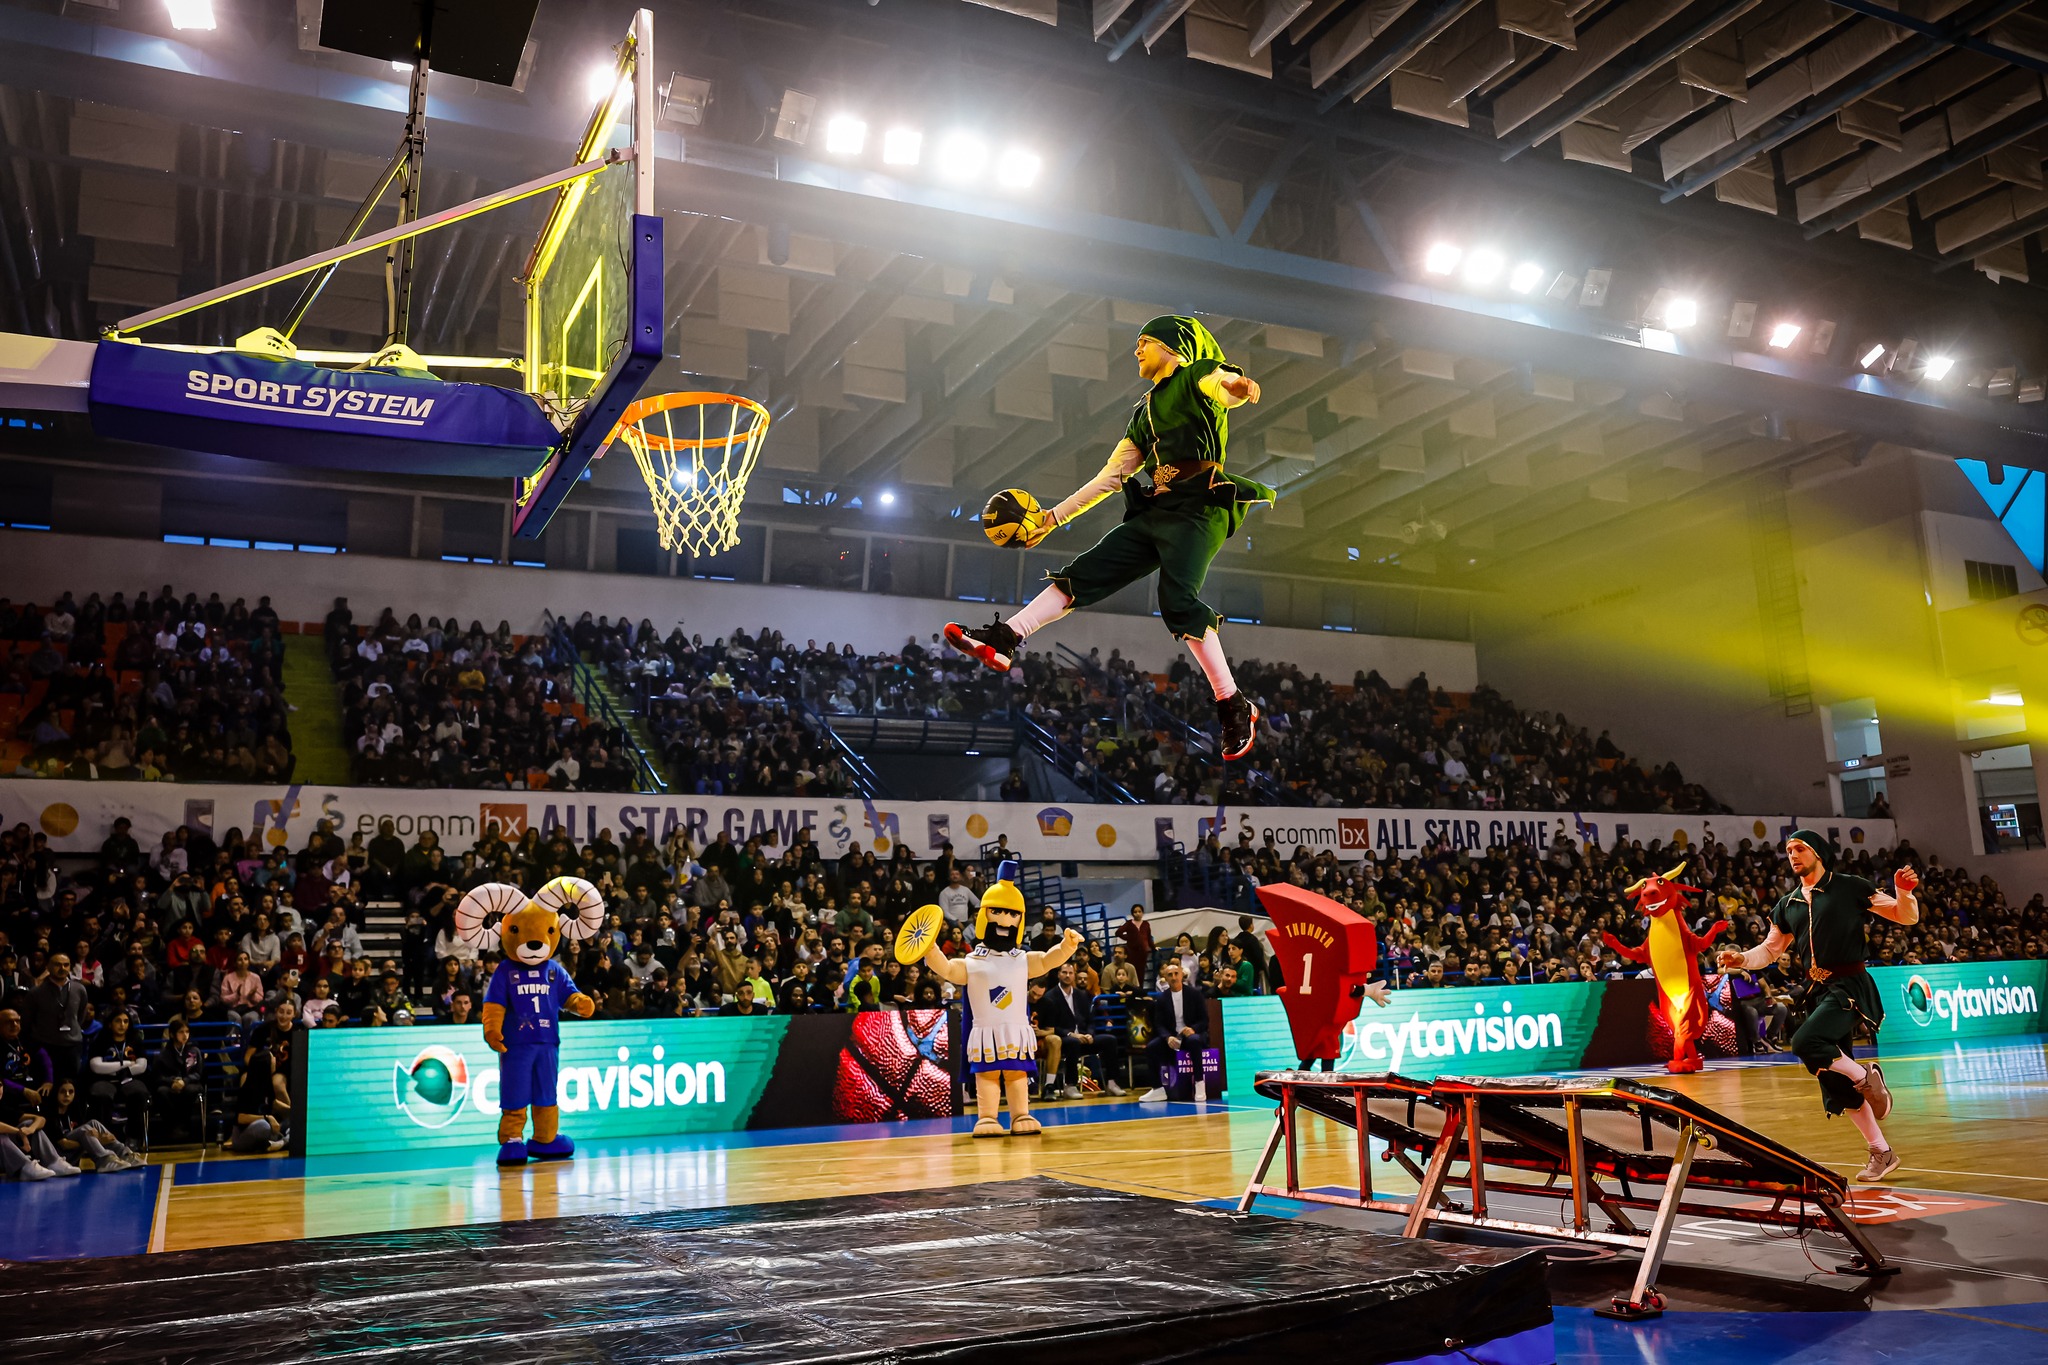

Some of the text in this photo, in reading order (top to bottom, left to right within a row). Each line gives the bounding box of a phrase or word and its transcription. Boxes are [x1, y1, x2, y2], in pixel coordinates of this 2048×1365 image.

[618, 805, 709, 846] STAR
[722, 808, 819, 847] GAME
[1376, 818, 1418, 850] ALL
[1424, 818, 1481, 850] STAR
[1489, 819, 1548, 850] GAME
[1285, 922, 1335, 949] THUNDER
[1299, 953, 1313, 995] 1
[531, 995, 541, 1014] 1
[1934, 974, 2038, 1032] cytavision
[1359, 1000, 1563, 1073] cytavision
[472, 1044, 726, 1115] cavision
